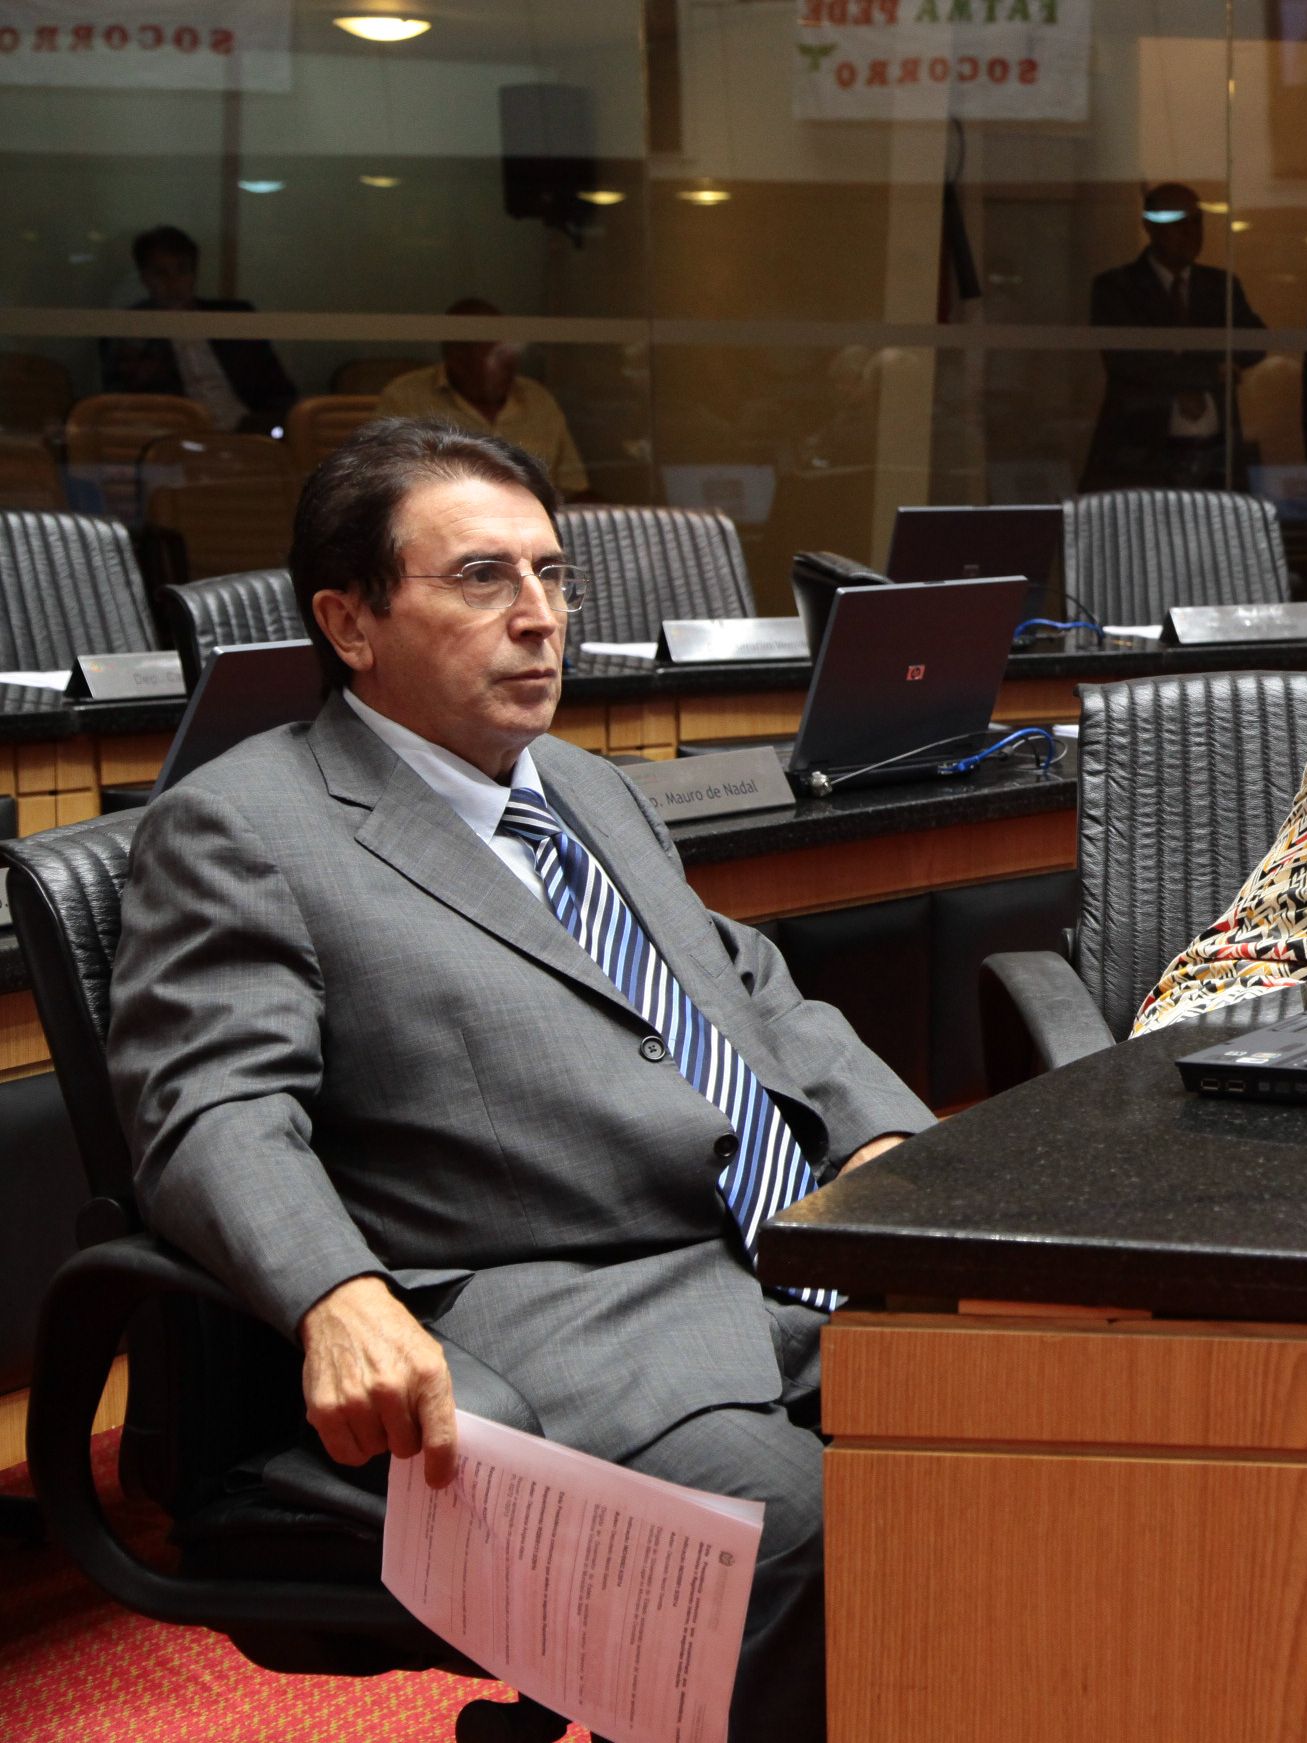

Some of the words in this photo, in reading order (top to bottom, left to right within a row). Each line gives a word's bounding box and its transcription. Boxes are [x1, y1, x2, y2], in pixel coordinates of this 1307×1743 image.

[665, 789, 704, 806] Mauro
[706, 785, 721, 799] de
[723, 779, 759, 797] Nadal
